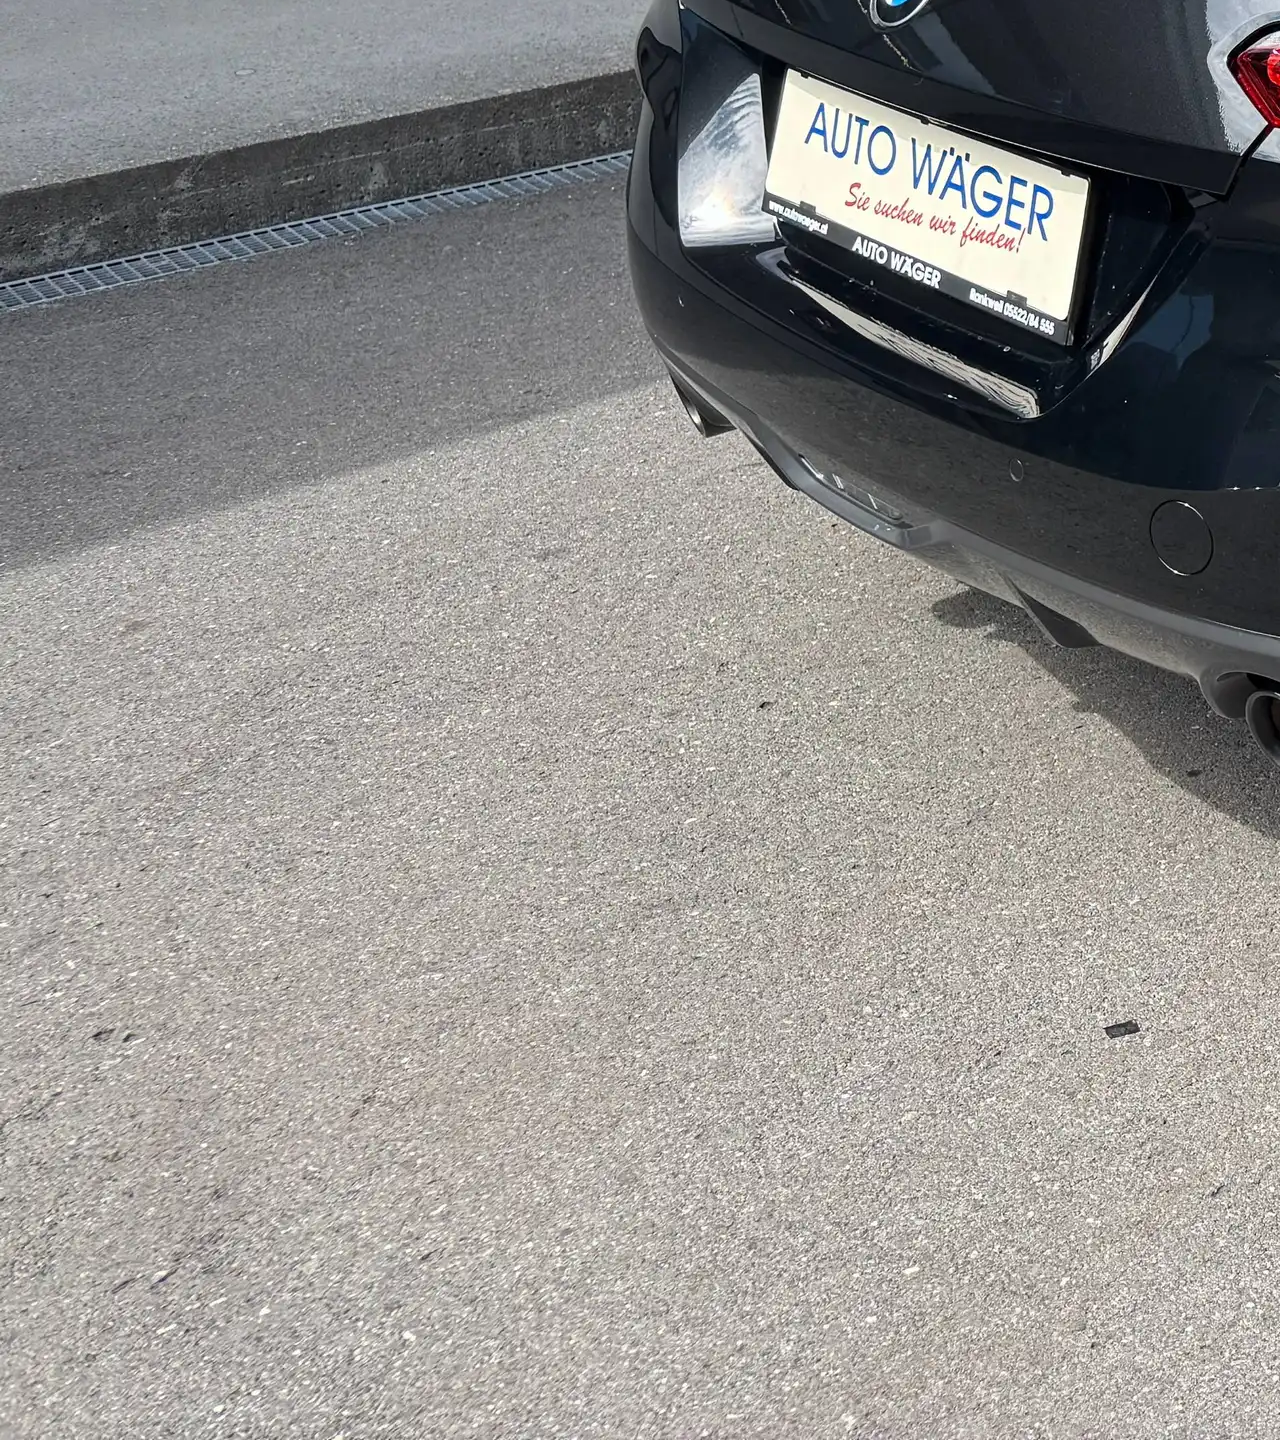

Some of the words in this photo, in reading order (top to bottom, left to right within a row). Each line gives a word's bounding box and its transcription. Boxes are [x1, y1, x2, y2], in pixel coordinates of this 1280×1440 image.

[804, 102, 897, 176] AUTO
[911, 137, 1054, 242] WÄGER
[844, 181, 870, 211] Sie
[874, 197, 923, 227] suchen
[929, 213, 957, 235] wir
[959, 216, 1026, 253] finden!
[851, 236, 888, 266] AUTO
[890, 250, 942, 289] WÄGER
[1039, 318, 1055, 336] 555
